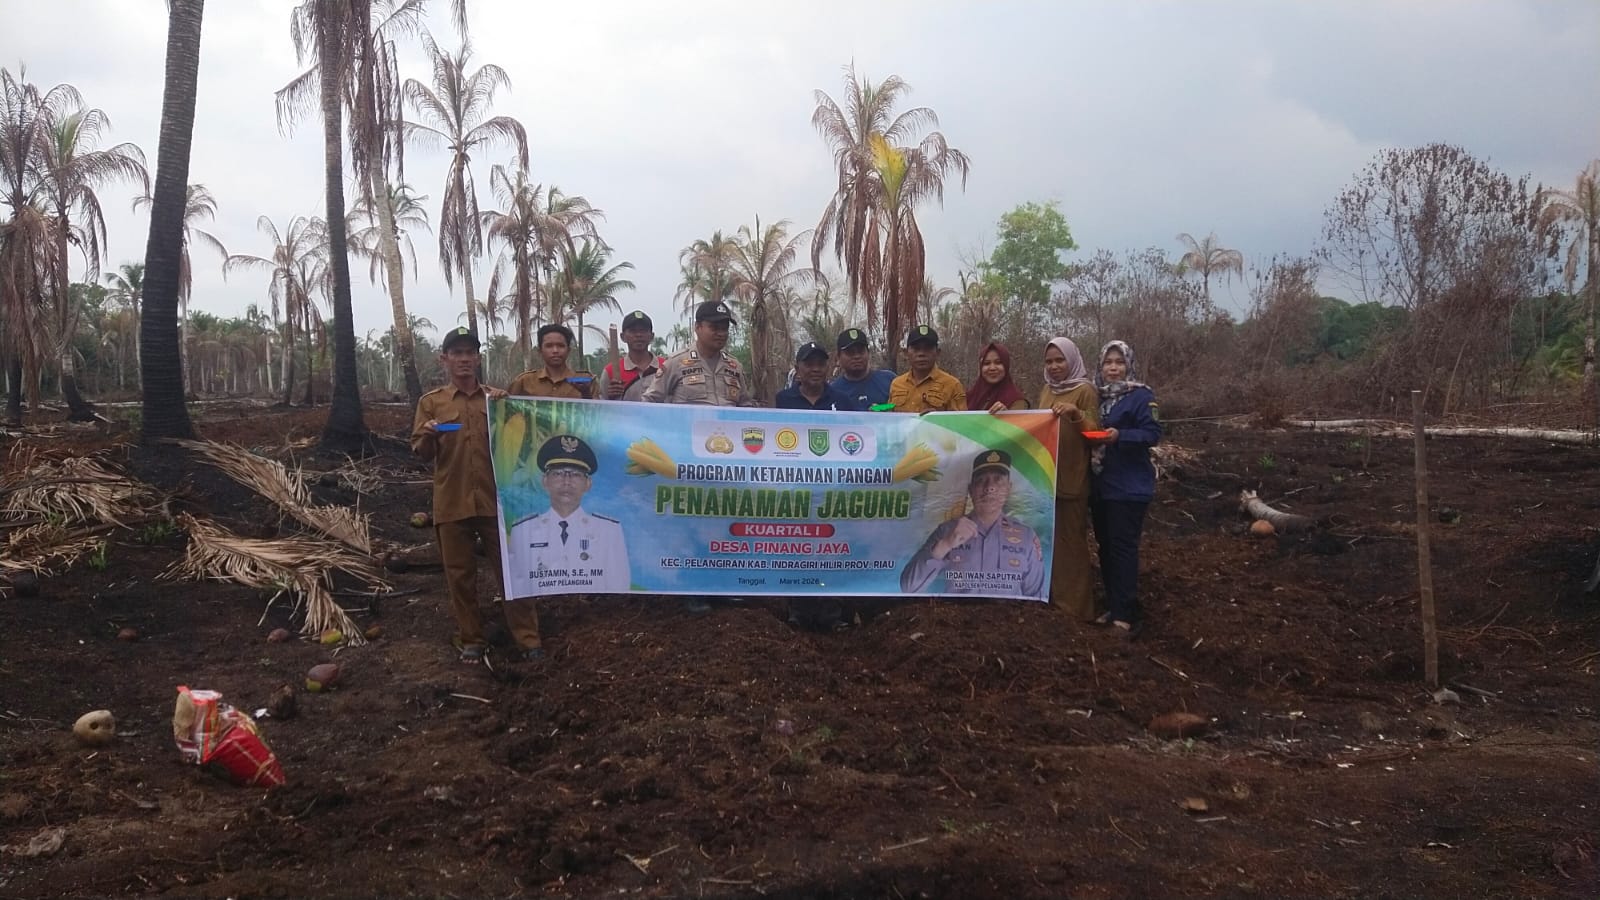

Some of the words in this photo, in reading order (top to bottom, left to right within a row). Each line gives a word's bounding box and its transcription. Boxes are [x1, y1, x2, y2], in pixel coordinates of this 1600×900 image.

[677, 464, 746, 481] PROGRAM
[750, 466, 833, 483] KETAHANAN
[837, 468, 892, 484] PANGAN
[656, 486, 811, 519] PENANAMAN
[817, 490, 911, 520] JAGUNG
[745, 524, 811, 536] KUARTAL
[815, 526, 820, 536] I
[710, 541, 750, 553] DESA
[754, 542, 812, 554] PINANG
[815, 543, 850, 554] JAYA
[661, 558, 682, 567] KEC.
[685, 559, 745, 569] PELANGIRAN
[747, 560, 769, 569] KAB.
[771, 560, 818, 569] INDRAGIRI
[820, 560, 843, 569] HILIR
[845, 561, 871, 569] PROV.
[873, 560, 895, 569] RIAU
[529, 569, 570, 579] BUSTAMIN,
[572, 569, 588, 577] S.E.,
[590, 569, 603, 577] MM
[946, 571, 963, 579] IPDA
[965, 572, 985, 580] IWAN
